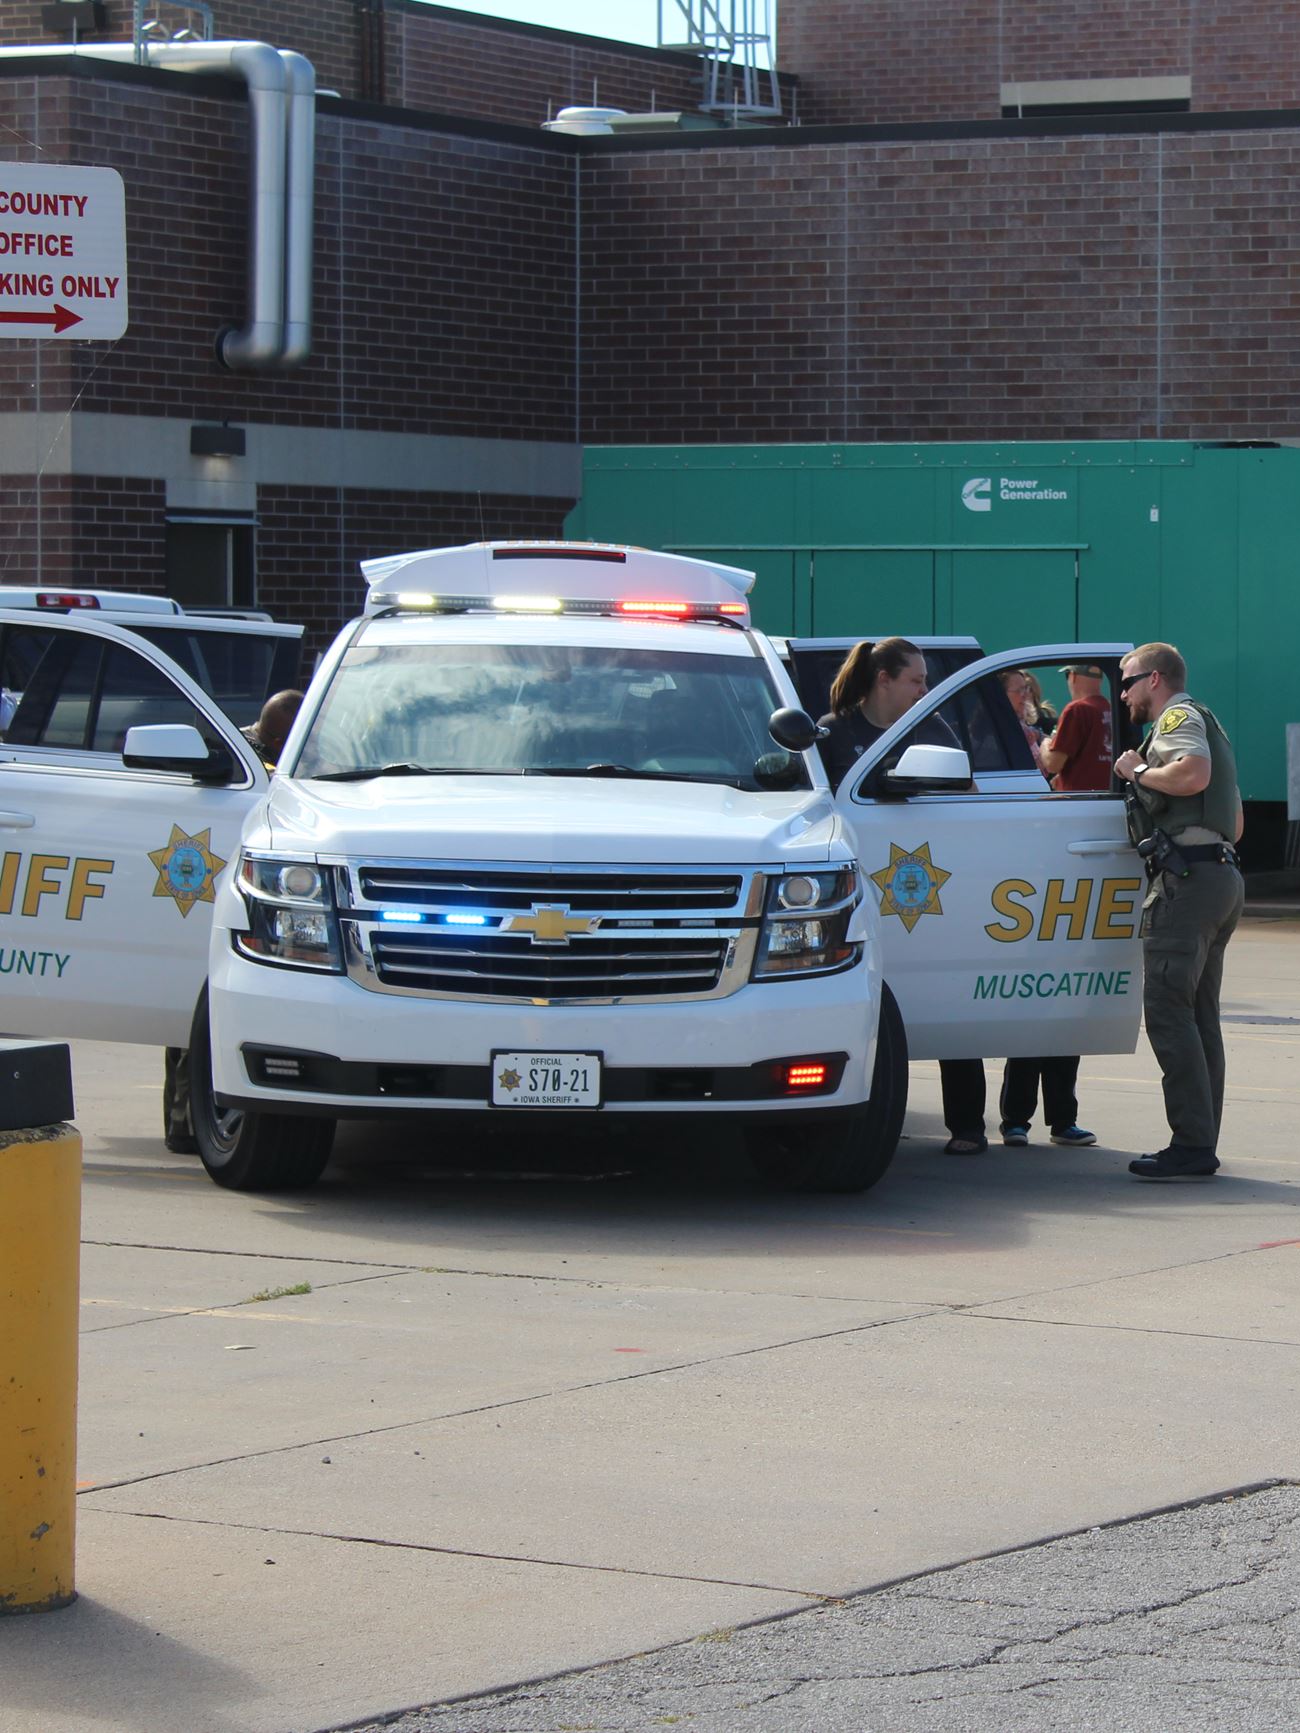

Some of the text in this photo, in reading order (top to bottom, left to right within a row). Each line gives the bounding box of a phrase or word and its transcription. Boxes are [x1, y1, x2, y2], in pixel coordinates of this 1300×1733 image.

[0, 191, 88, 217] COUNTY
[0, 232, 74, 257] OFFICE
[61, 275, 120, 298] ONLY
[1000, 478, 1038, 488] Power
[1000, 489, 1067, 500] Generation
[984, 877, 1147, 943] SHE
[0, 949, 71, 977] UNTY
[973, 970, 1132, 1000] MUSCATINE
[530, 1057, 563, 1066] OFFICIAL
[529, 1068, 590, 1092] S70-21
[520, 1095, 572, 1104] IOWA SHERIFF
